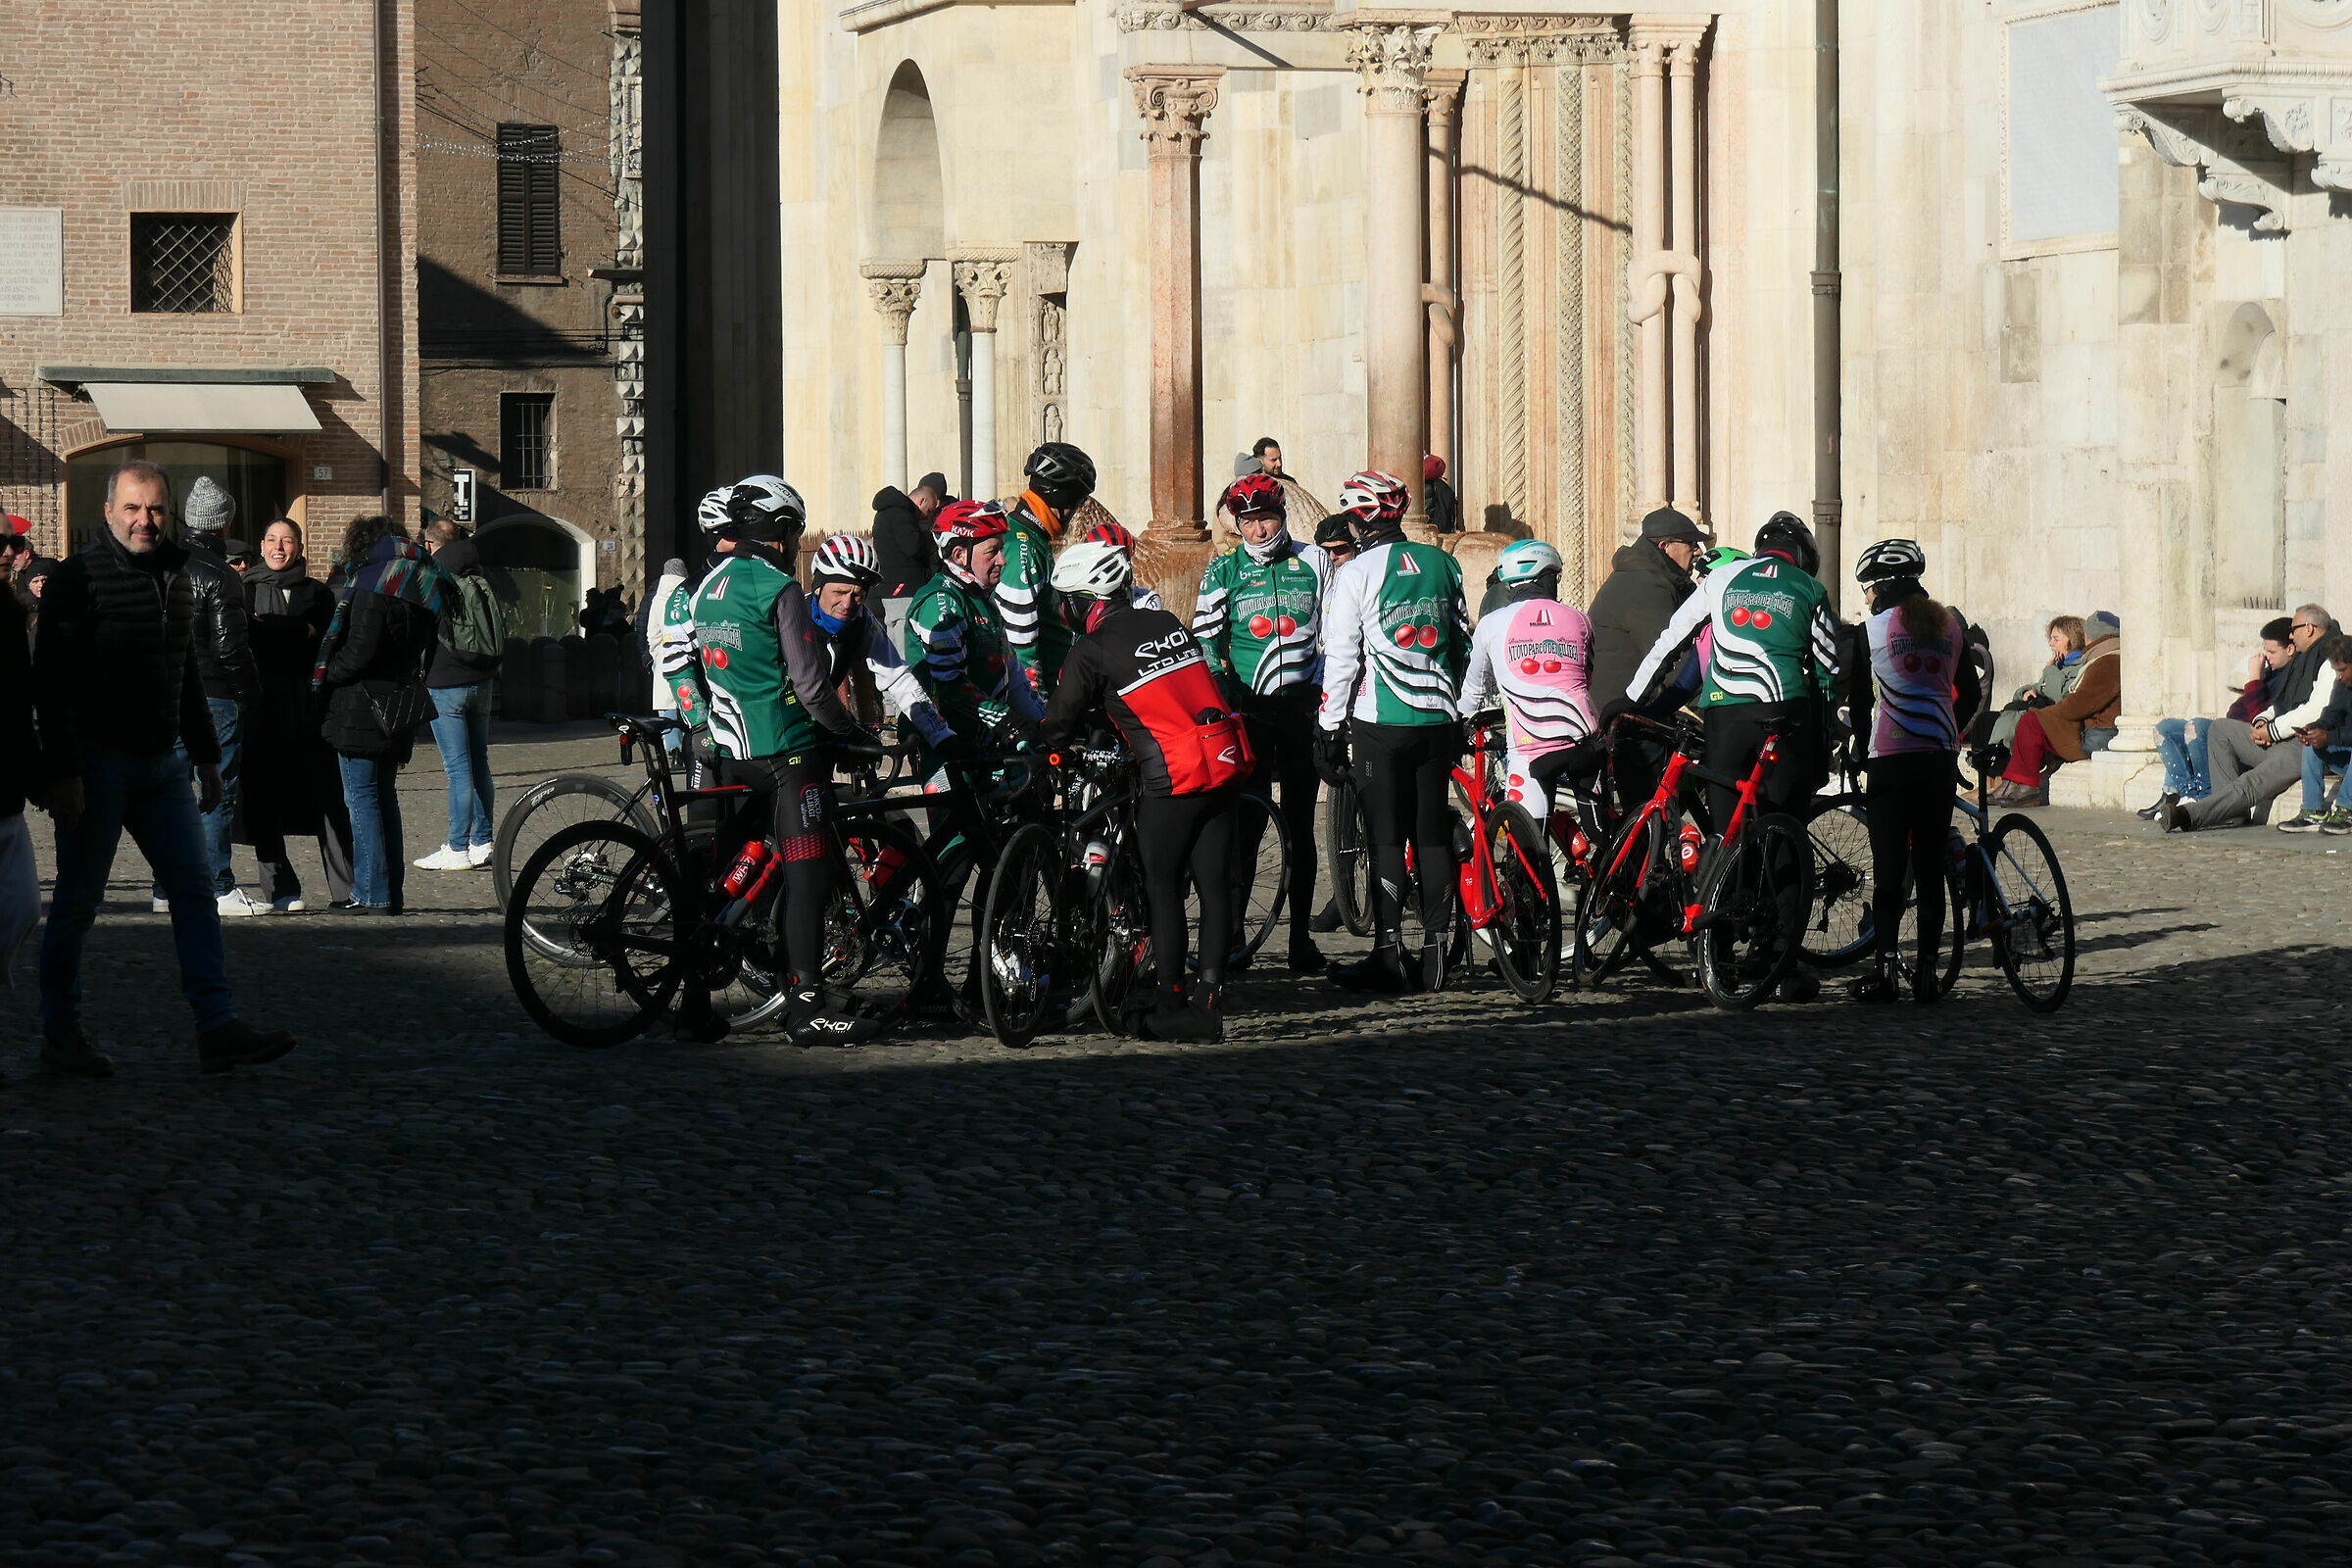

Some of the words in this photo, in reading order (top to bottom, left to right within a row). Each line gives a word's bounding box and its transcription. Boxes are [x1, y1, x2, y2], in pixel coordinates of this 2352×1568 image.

[318, 468, 328, 478] 57
[951, 525, 974, 537] KASK
[1529, 643, 1546, 656] PARCO
[1138, 657, 1175, 677] LTD
[806, 789, 816, 817] CILIEGI
[812, 788, 822, 814] PARCO
